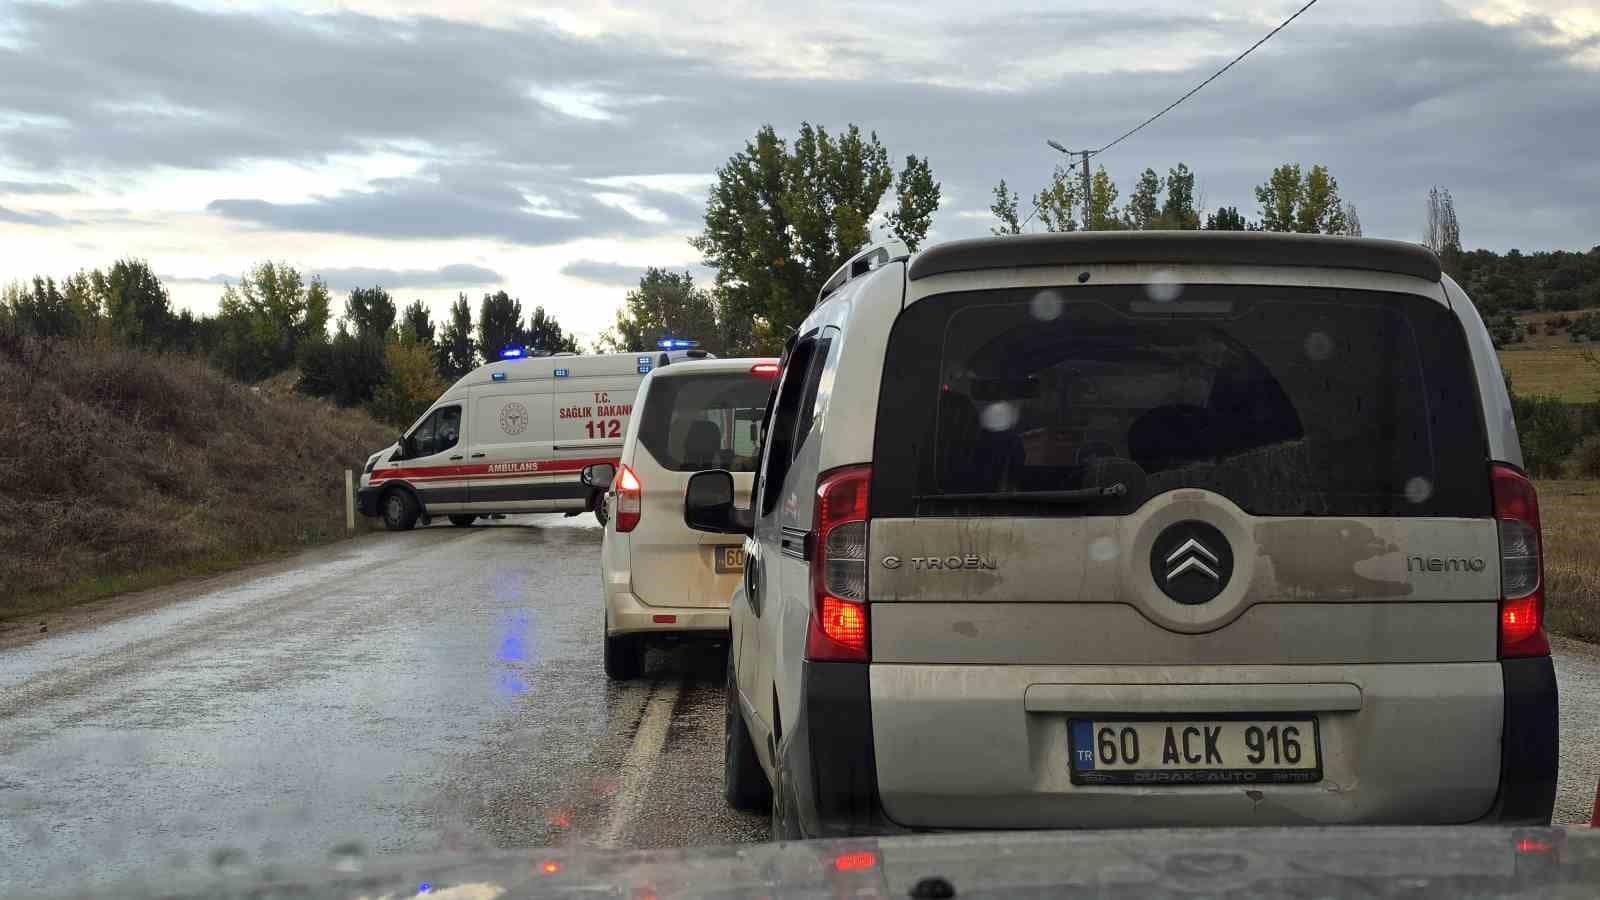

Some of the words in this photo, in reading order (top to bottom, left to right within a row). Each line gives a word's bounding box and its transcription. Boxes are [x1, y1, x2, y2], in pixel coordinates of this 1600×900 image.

[594, 393, 611, 404] T.C.
[559, 406, 592, 419] SAĞLIK
[585, 420, 621, 439] 112
[488, 463, 538, 473] AMBULANS
[1097, 727, 1140, 765] 60
[1162, 726, 1223, 765] ACK
[1244, 726, 1301, 764] 916
[1078, 751, 1093, 761] TR
